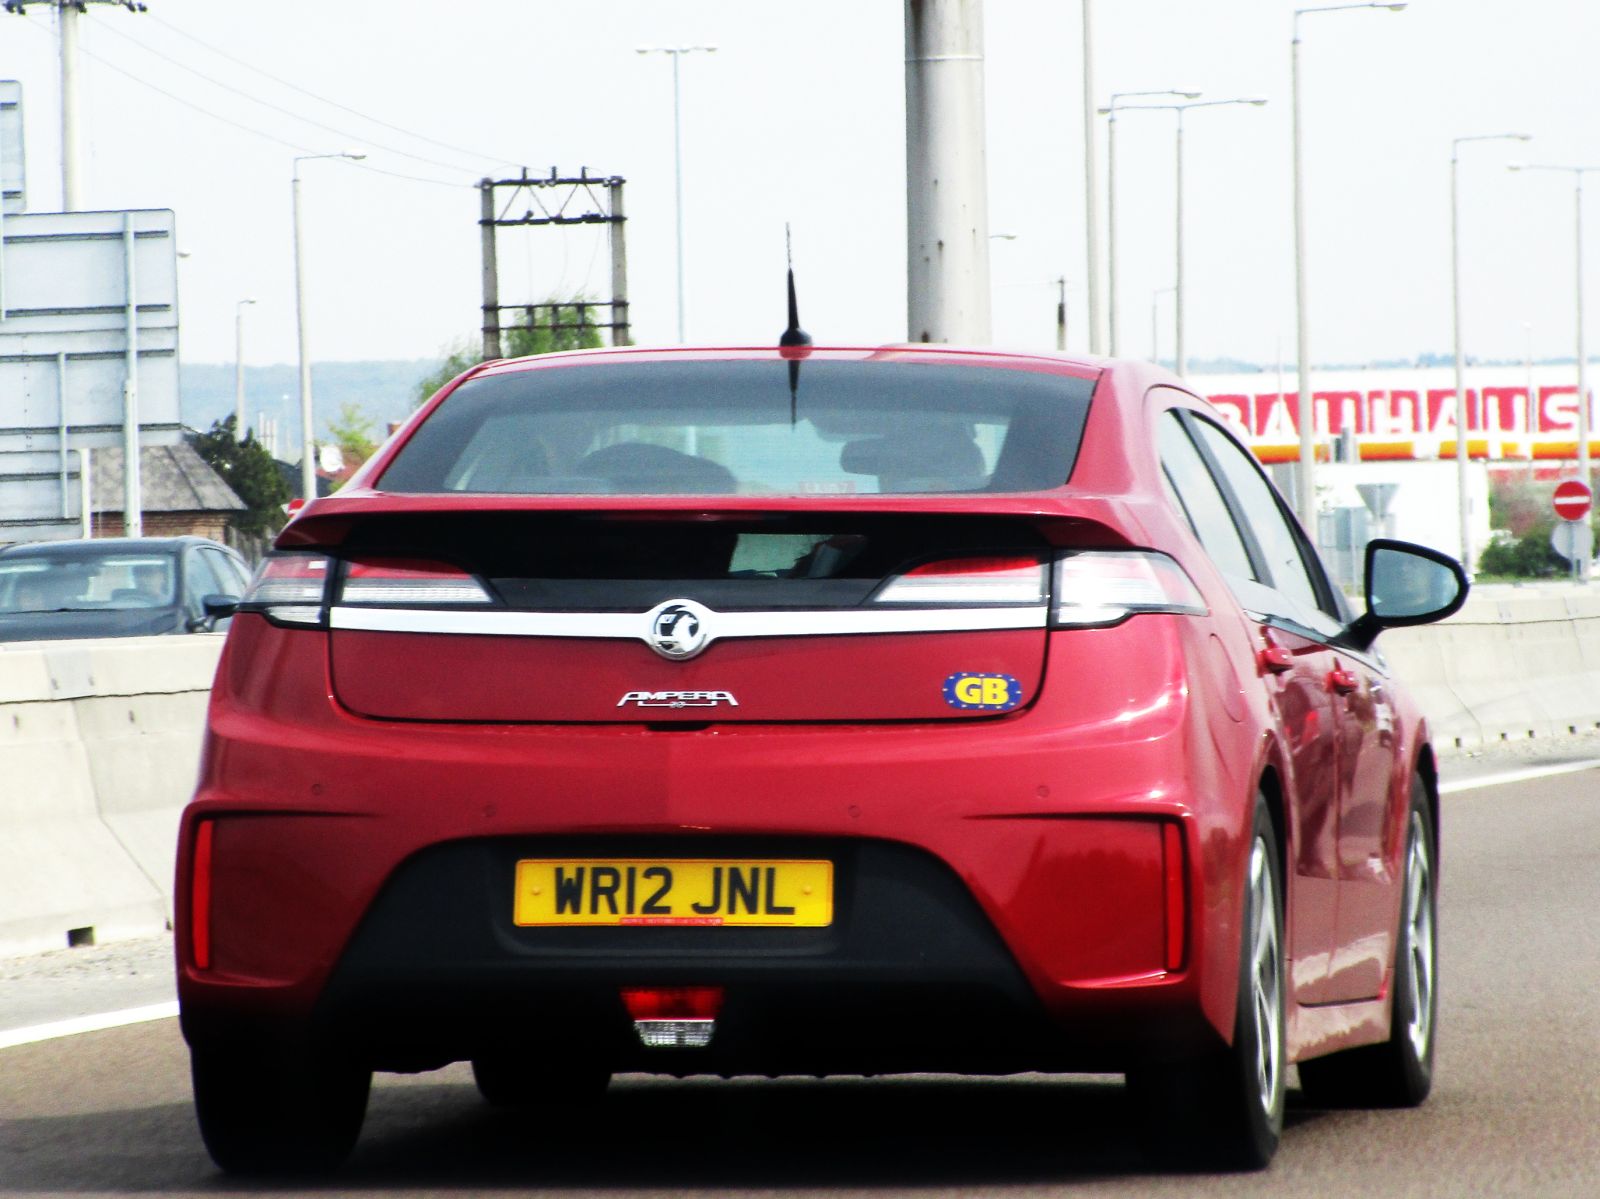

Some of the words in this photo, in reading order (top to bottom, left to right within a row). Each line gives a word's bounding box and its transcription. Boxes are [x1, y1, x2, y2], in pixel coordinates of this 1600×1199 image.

[616, 691, 739, 707] AMPERA
[955, 677, 1009, 705] GB
[554, 866, 673, 915] WR12
[691, 866, 796, 915] JNL
